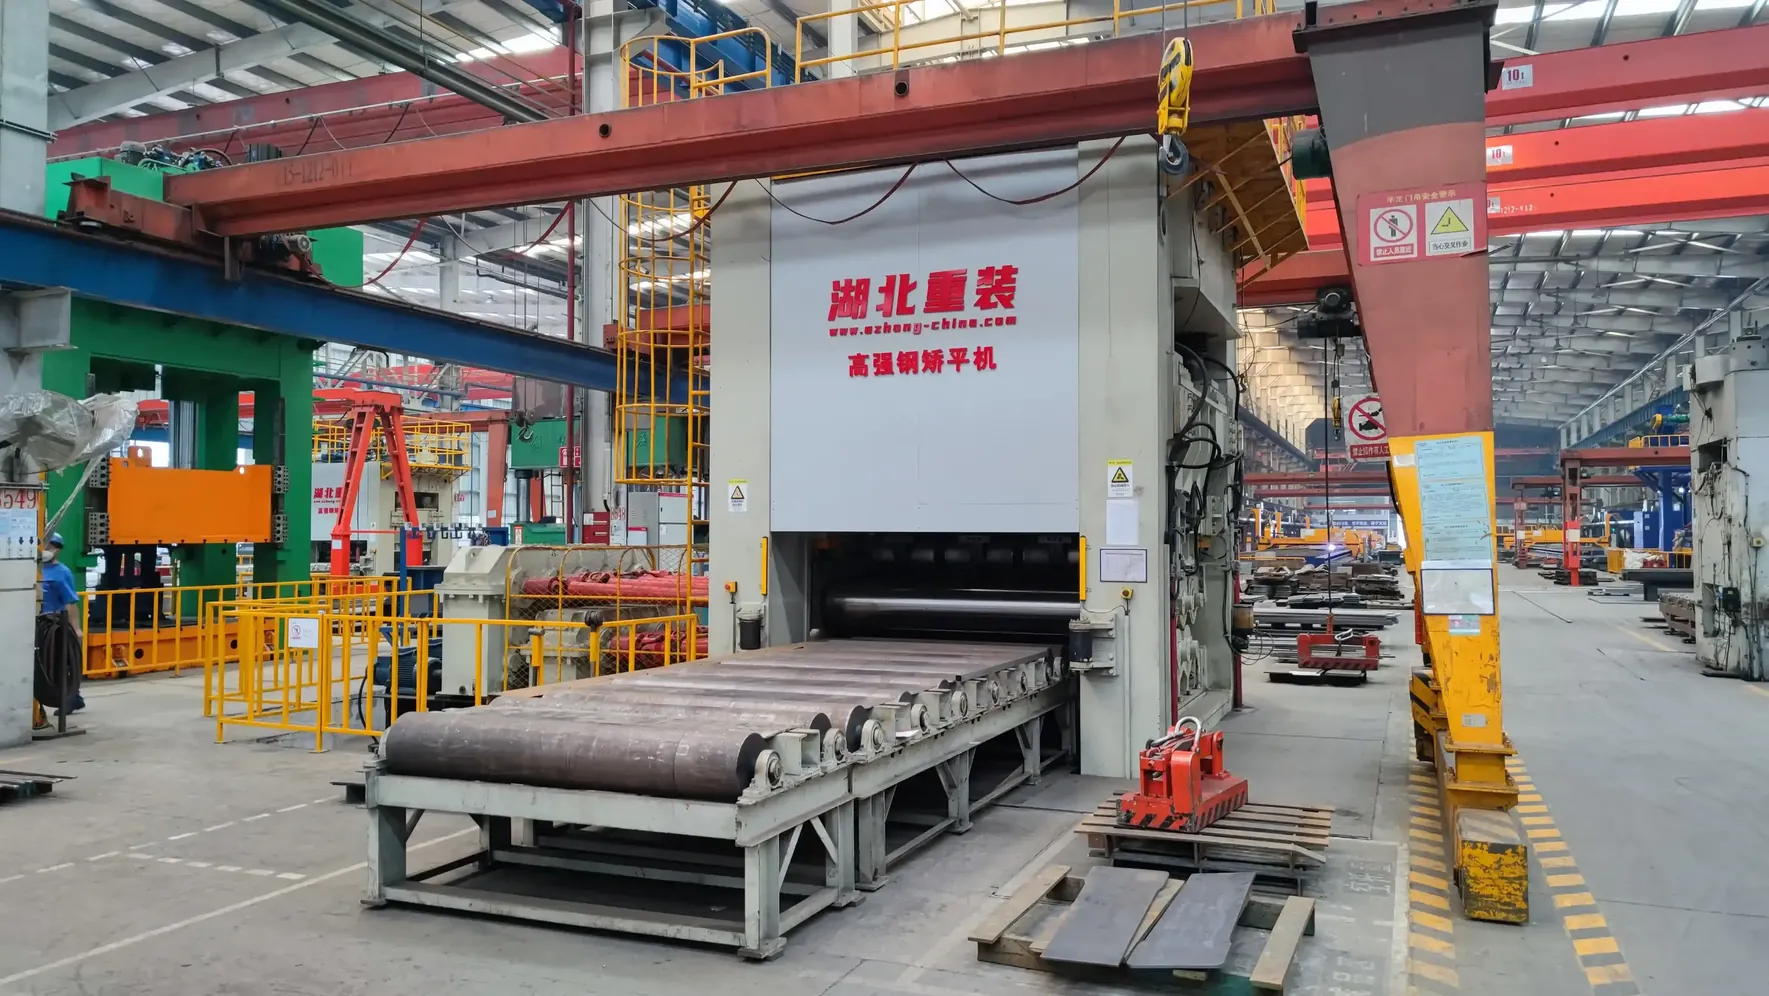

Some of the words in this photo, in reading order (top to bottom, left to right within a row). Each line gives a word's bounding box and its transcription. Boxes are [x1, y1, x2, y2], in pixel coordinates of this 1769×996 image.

[1507, 69, 1525, 81] 10t
[828, 265, 1019, 321] 湖北重装
[828, 316, 1018, 337] www.ezhong-china.com
[848, 346, 998, 378] 高强钢矫平机
[0, 489, 37, 509] 549
